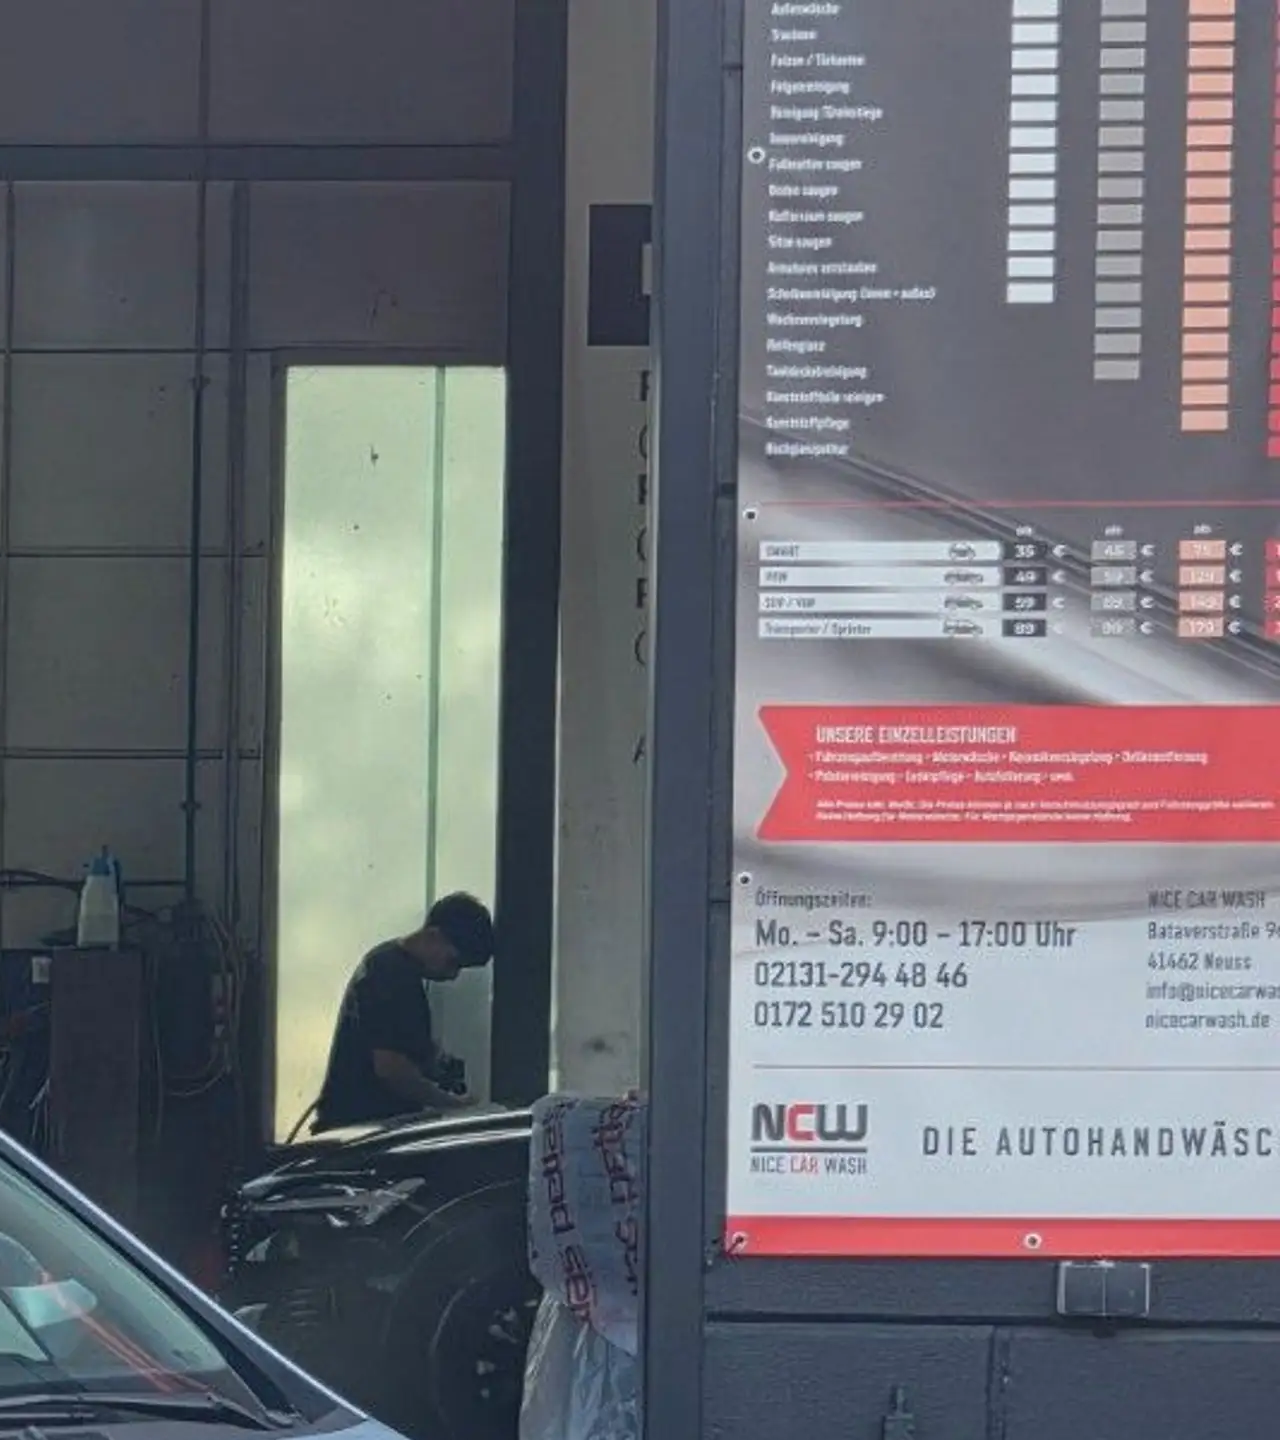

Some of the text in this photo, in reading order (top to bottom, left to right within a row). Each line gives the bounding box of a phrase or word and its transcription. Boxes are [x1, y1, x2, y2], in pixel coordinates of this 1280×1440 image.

[816, 726, 1017, 743] UNSERE EINZELLEISTUNGEN
[1221, 889, 1266, 909] WASH
[756, 918, 798, 947] Mo.
[828, 919, 865, 948] Sa.
[872, 920, 928, 947] 9:00
[959, 920, 1027, 948] 17:00
[1035, 920, 1079, 947] Uhr
[1203, 951, 1253, 970] Neuss
[755, 961, 969, 989] 02131-294 48 46
[754, 1001, 944, 1028] 0172 510 29 02
[752, 1103, 868, 1141] NCW
[922, 1126, 978, 1156] DIE
[750, 1156, 868, 1174] NICE CAR WASH
